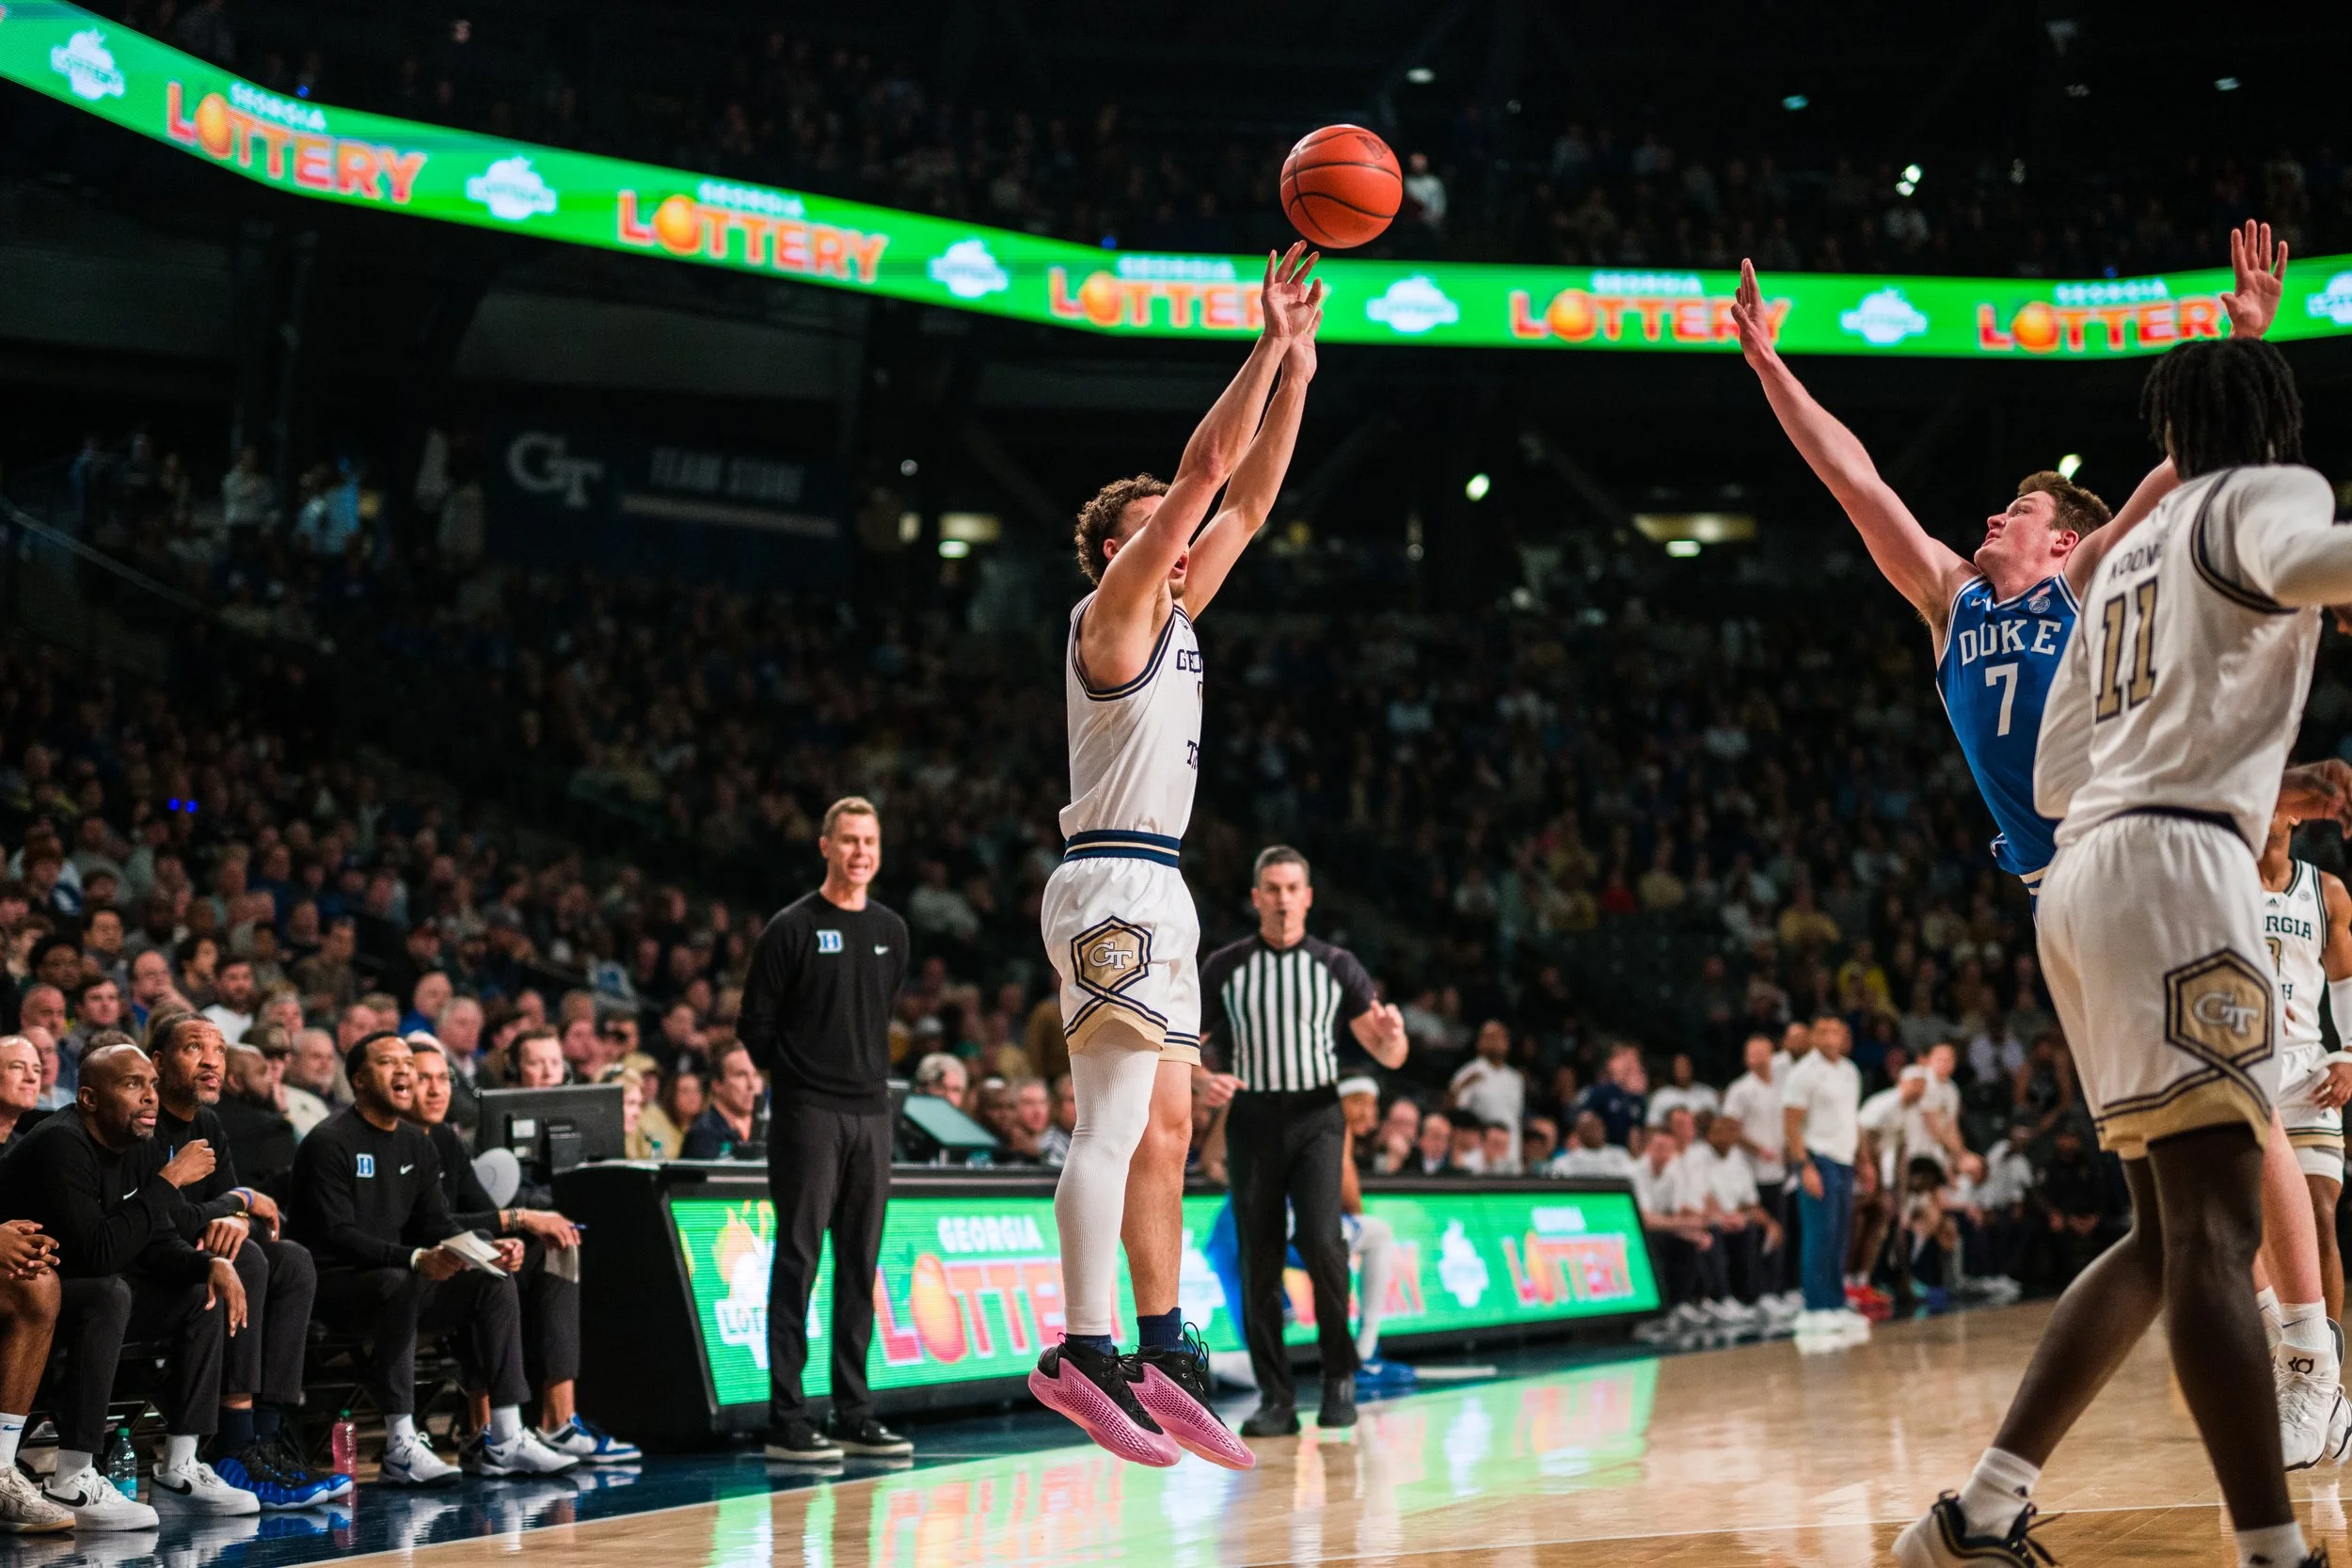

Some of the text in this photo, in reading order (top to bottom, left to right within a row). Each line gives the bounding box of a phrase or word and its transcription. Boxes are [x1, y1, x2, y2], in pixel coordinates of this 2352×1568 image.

[166, 80, 428, 204] LOTTERY
[616, 189, 890, 284] LOTTERY
[1048, 266, 1332, 331] LOTTE
[1978, 293, 2233, 354] LOTTER
[1959, 619, 2061, 667] DUKE
[2096, 576, 2158, 725] 11
[1985, 662, 2018, 737] 7
[1089, 942, 1133, 970] GT
[2265, 915, 2312, 941] RGIA
[2194, 991, 2259, 1035] GT
[937, 1215, 1044, 1253] GEORGIA
[872, 1253, 1126, 1366] LOTTE
